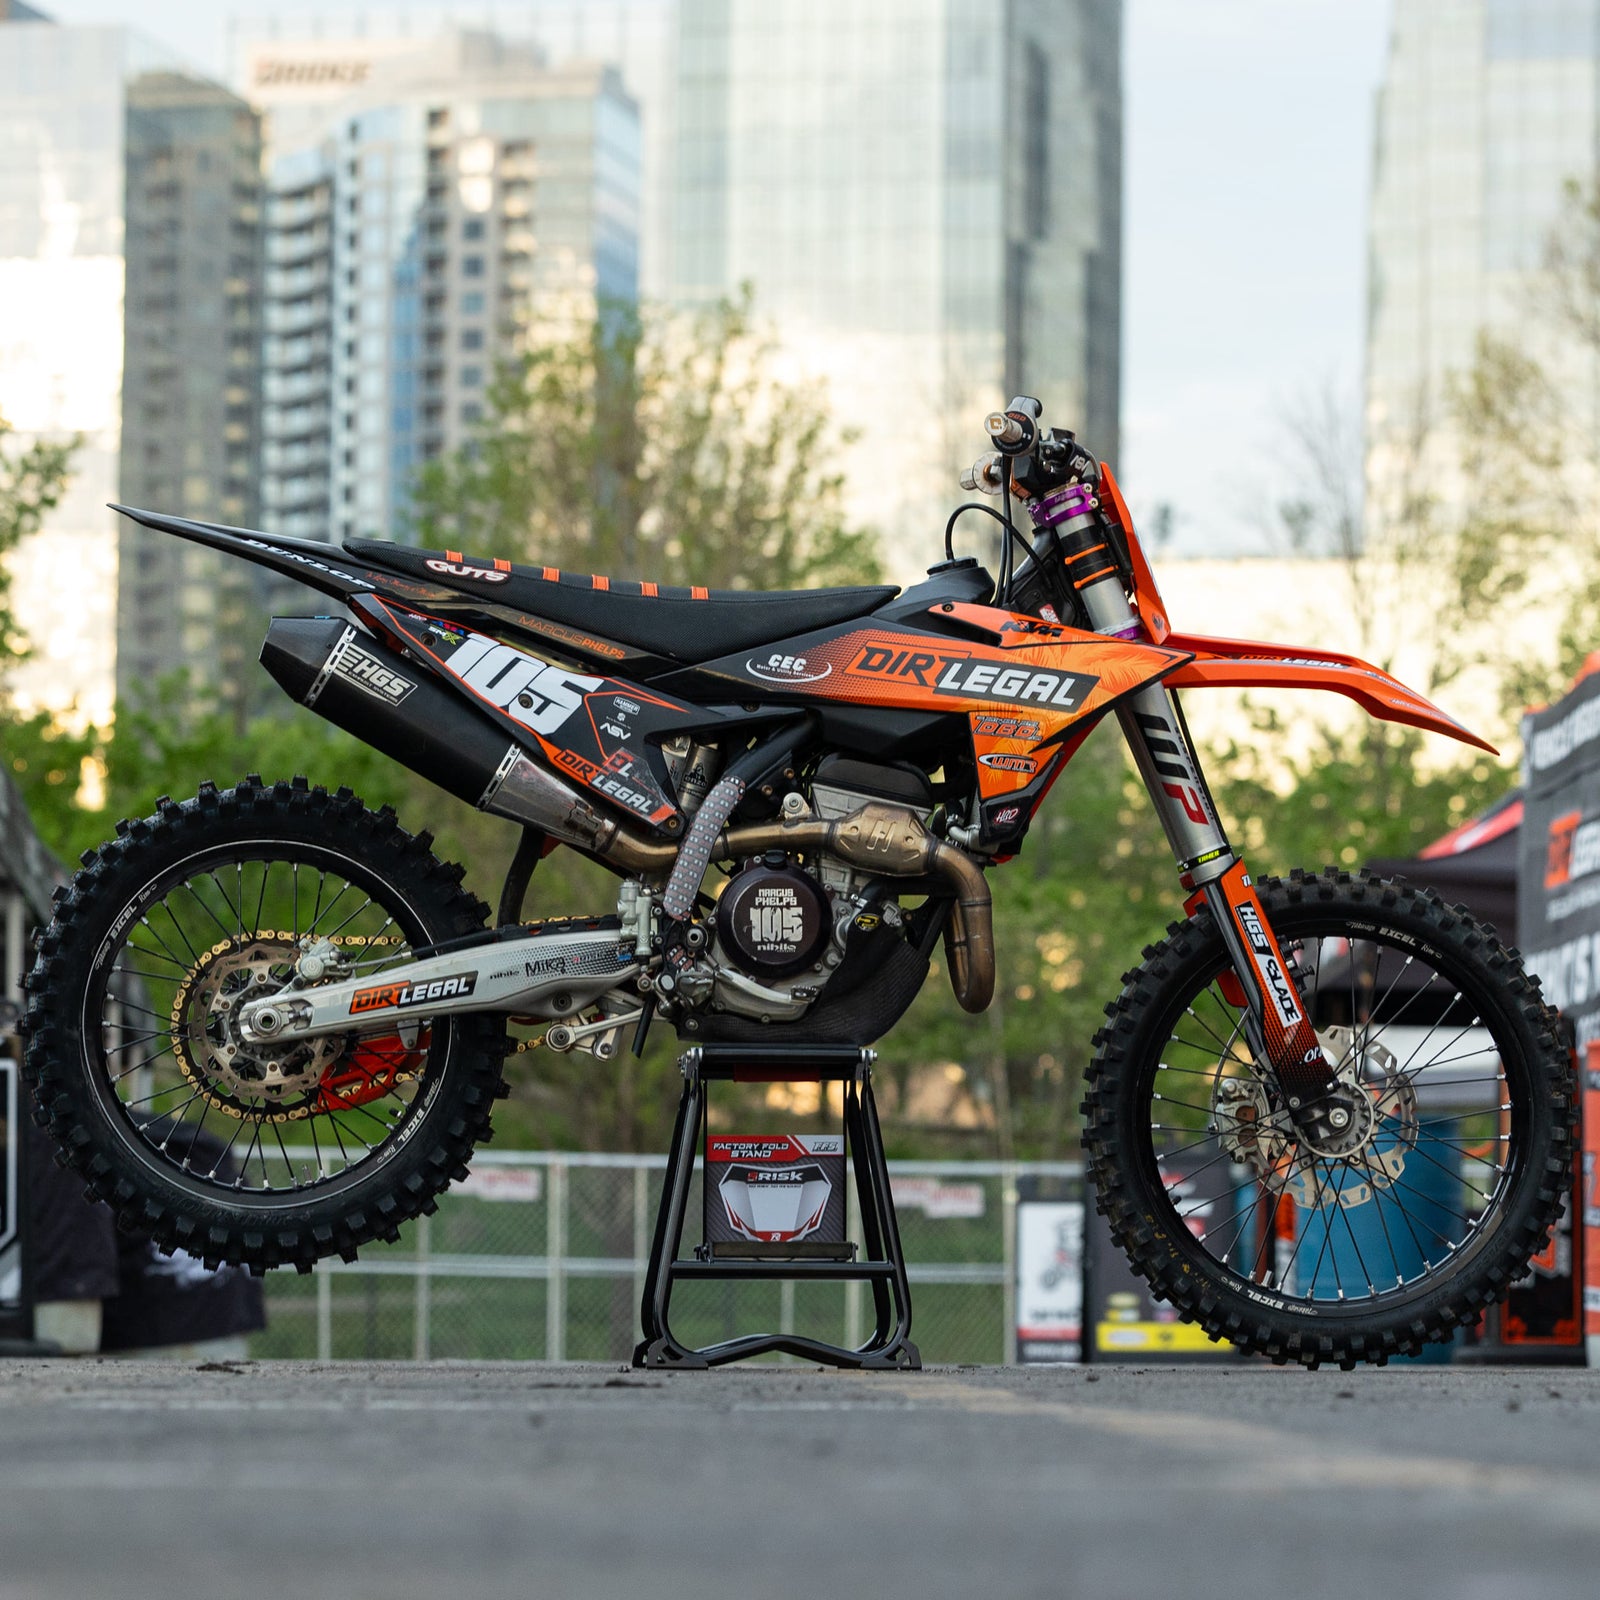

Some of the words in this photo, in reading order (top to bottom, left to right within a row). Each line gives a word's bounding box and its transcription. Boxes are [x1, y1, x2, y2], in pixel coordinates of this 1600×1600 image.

[426, 559, 508, 582] GUTS
[768, 654, 807, 671] CEC
[857, 646, 958, 687] DIRT
[938, 662, 1077, 706] LEGAL
[1281, 657, 1346, 669] LEGAL
[353, 658, 411, 697] HGS
[444, 633, 604, 735] 105
[560, 751, 600, 781] DIR
[591, 774, 653, 813] LEGAL
[755, 896, 798, 906] PHELPS
[758, 888, 794, 897] MARCUS
[110, 905, 137, 939] EXCEL
[749, 906, 803, 942] 105
[1240, 906, 1270, 949] HGS
[1379, 927, 1416, 946] EXCEL
[355, 983, 406, 1008] DIRT
[400, 977, 470, 1004] LEGAL
[397, 1108, 425, 1142] EXCEL
[712, 1142, 761, 1151] FACTORY
[762, 1142, 790, 1151] FOLD
[730, 1150, 772, 1159] STAND
[1247, 1289, 1284, 1309] EXCEL
